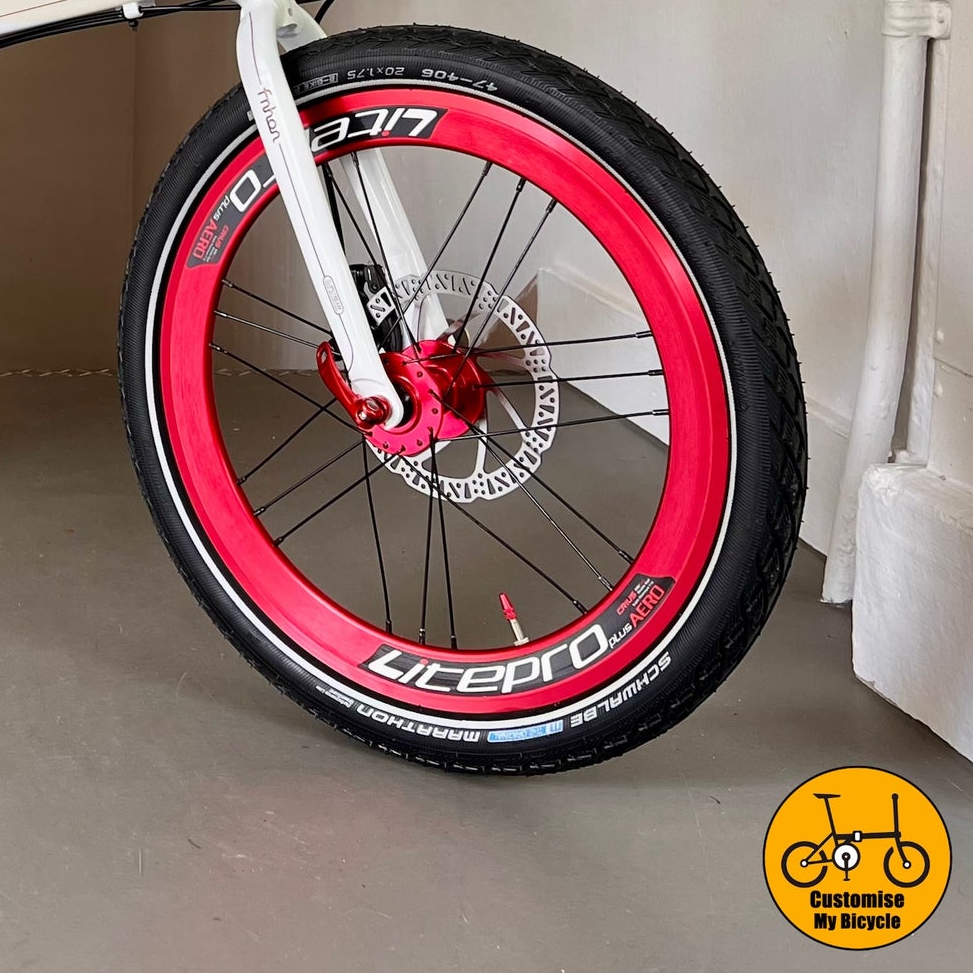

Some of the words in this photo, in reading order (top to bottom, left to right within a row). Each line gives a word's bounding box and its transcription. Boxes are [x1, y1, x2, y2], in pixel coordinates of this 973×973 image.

[257, 86, 280, 143] fnhon
[192, 218, 218, 259] AERO
[616, 590, 637, 615] CRIUS
[368, 624, 608, 695] Litepro
[629, 584, 665, 628] AERO
[570, 651, 672, 727] SCHWALBE
[356, 704, 480, 742] MARATHON
